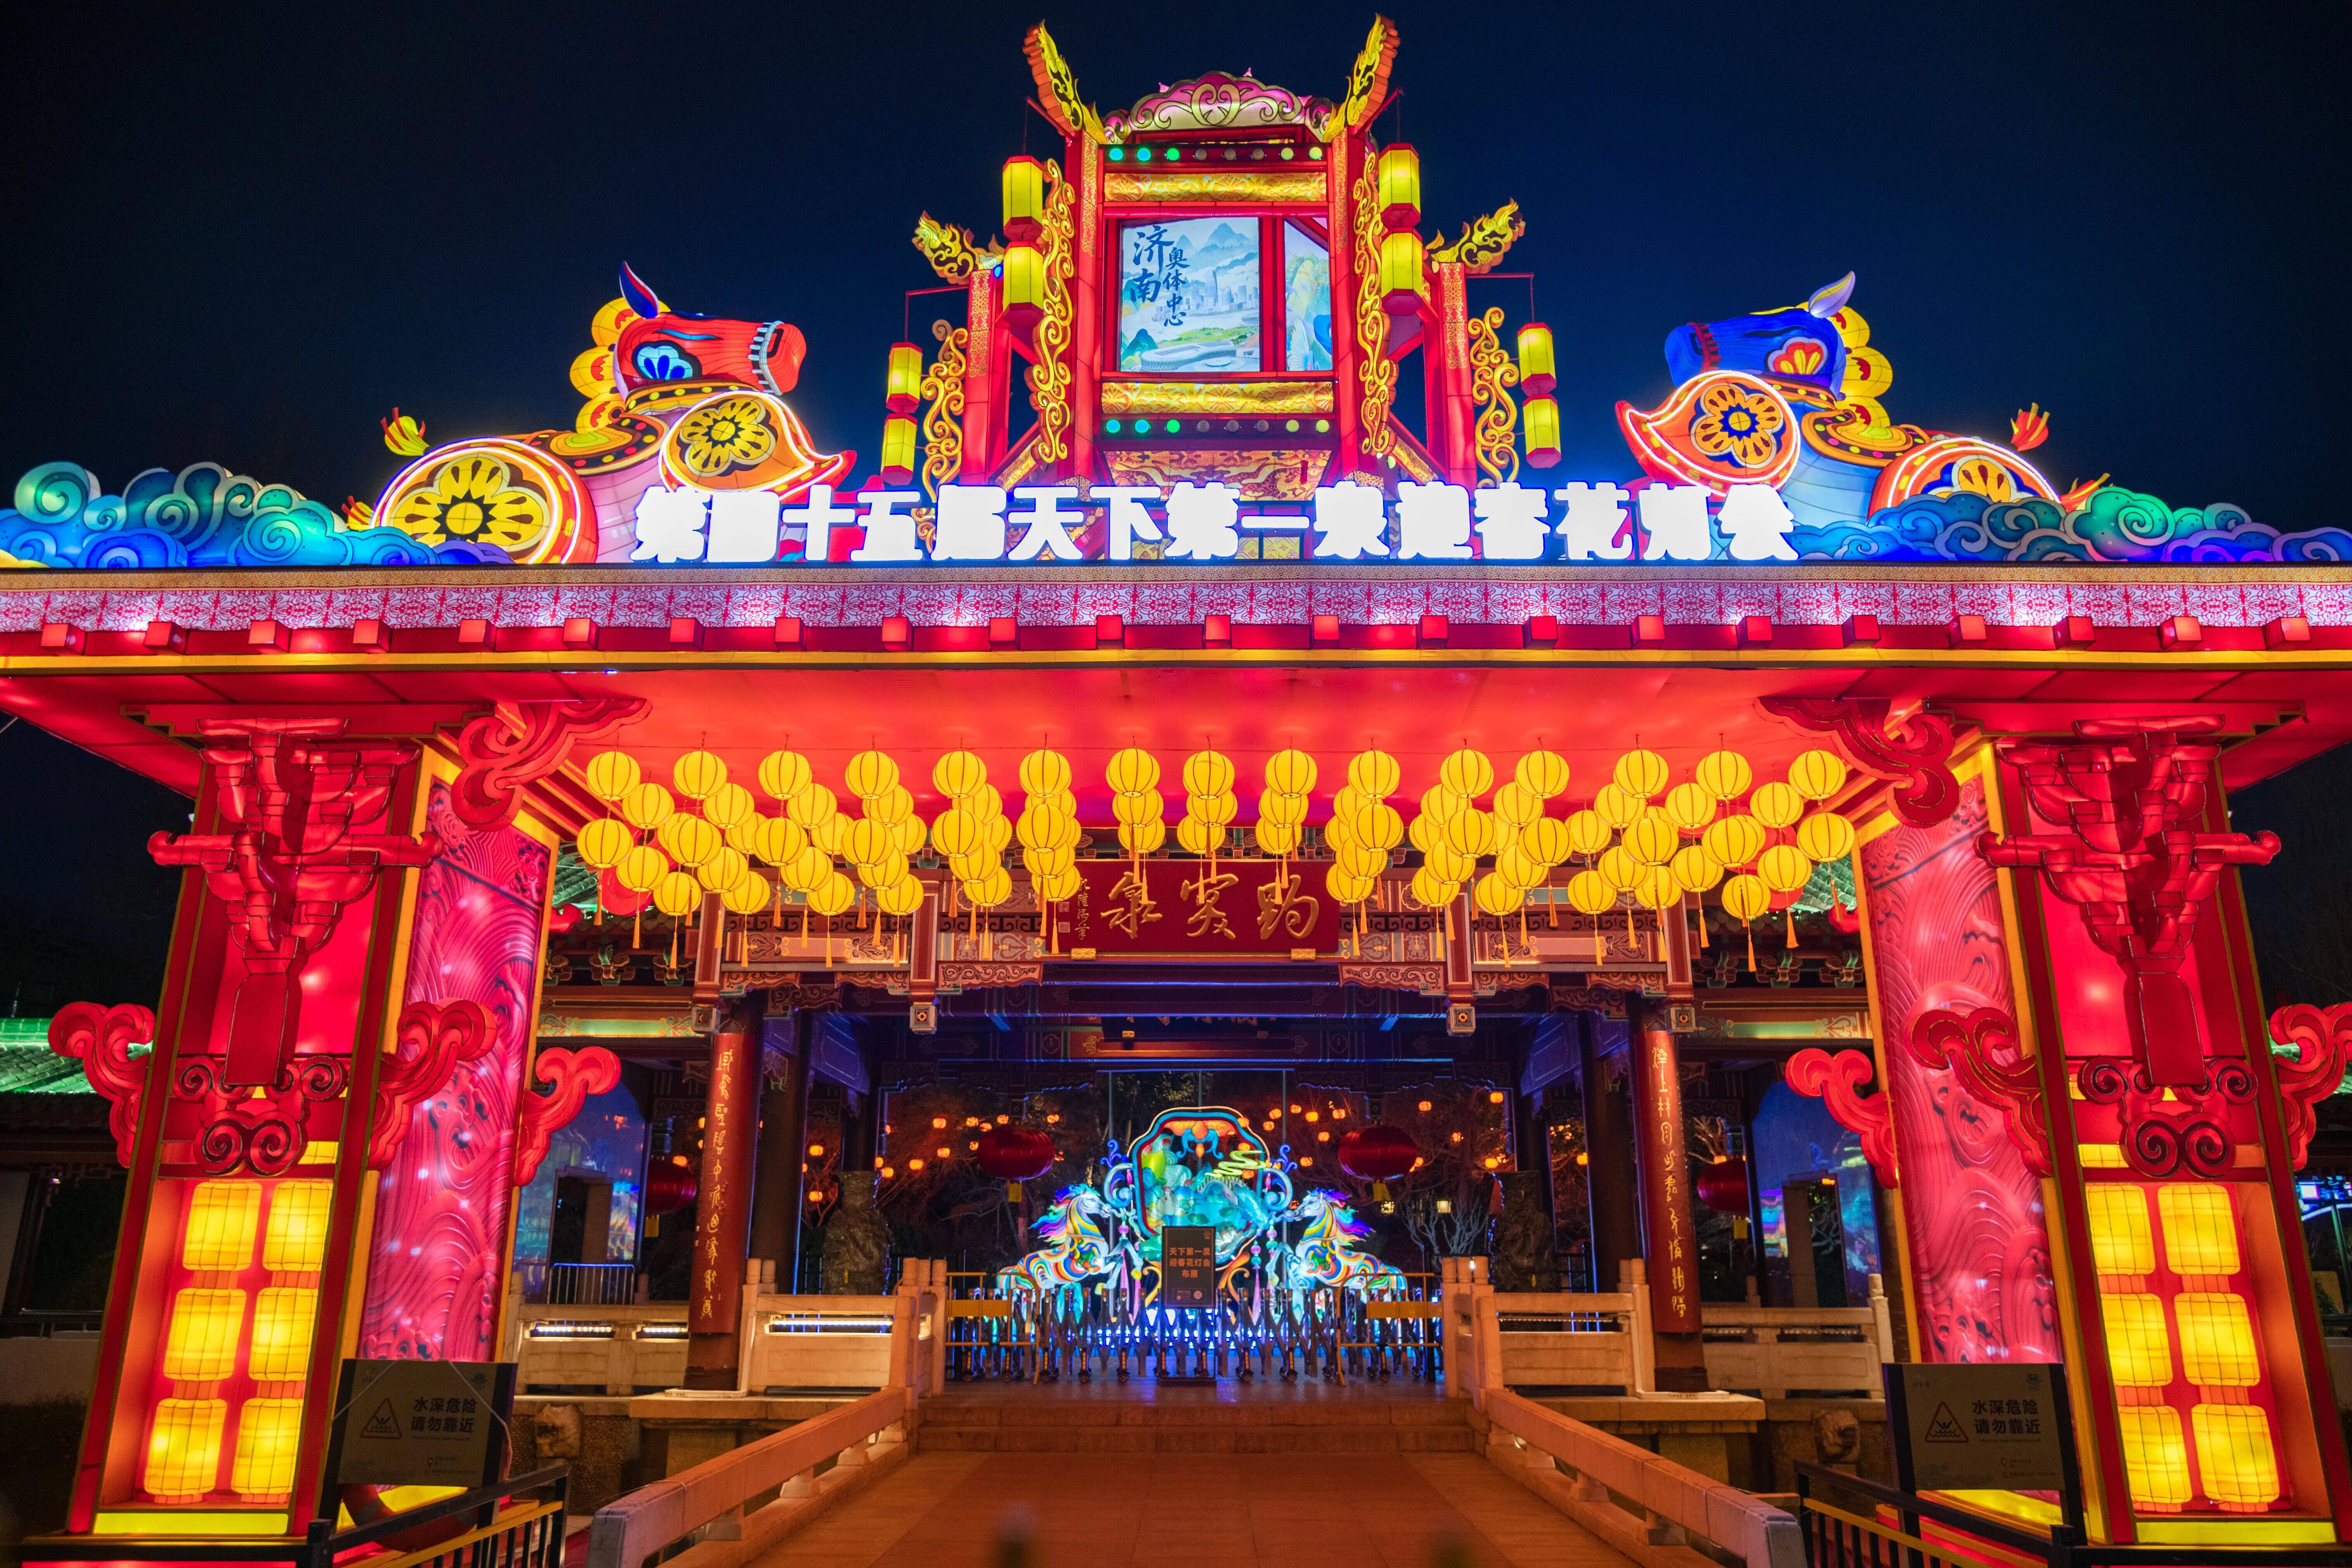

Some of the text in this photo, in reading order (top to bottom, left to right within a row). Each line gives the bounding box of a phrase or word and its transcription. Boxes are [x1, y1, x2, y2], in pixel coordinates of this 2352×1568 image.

[1130, 225, 1174, 304] 济南
[1162, 247, 1190, 327] 奥体中心
[1169, 1247, 1210, 1256] 天下第一泉
[1169, 1259, 1210, 1267] 迎春花灯会
[413, 1397, 478, 1414] 水深危险
[1972, 1399, 2038, 1415] 水深危险
[410, 1416, 475, 1433] 请勿靠近
[1974, 1419, 2041, 1435] 请勿靠近
